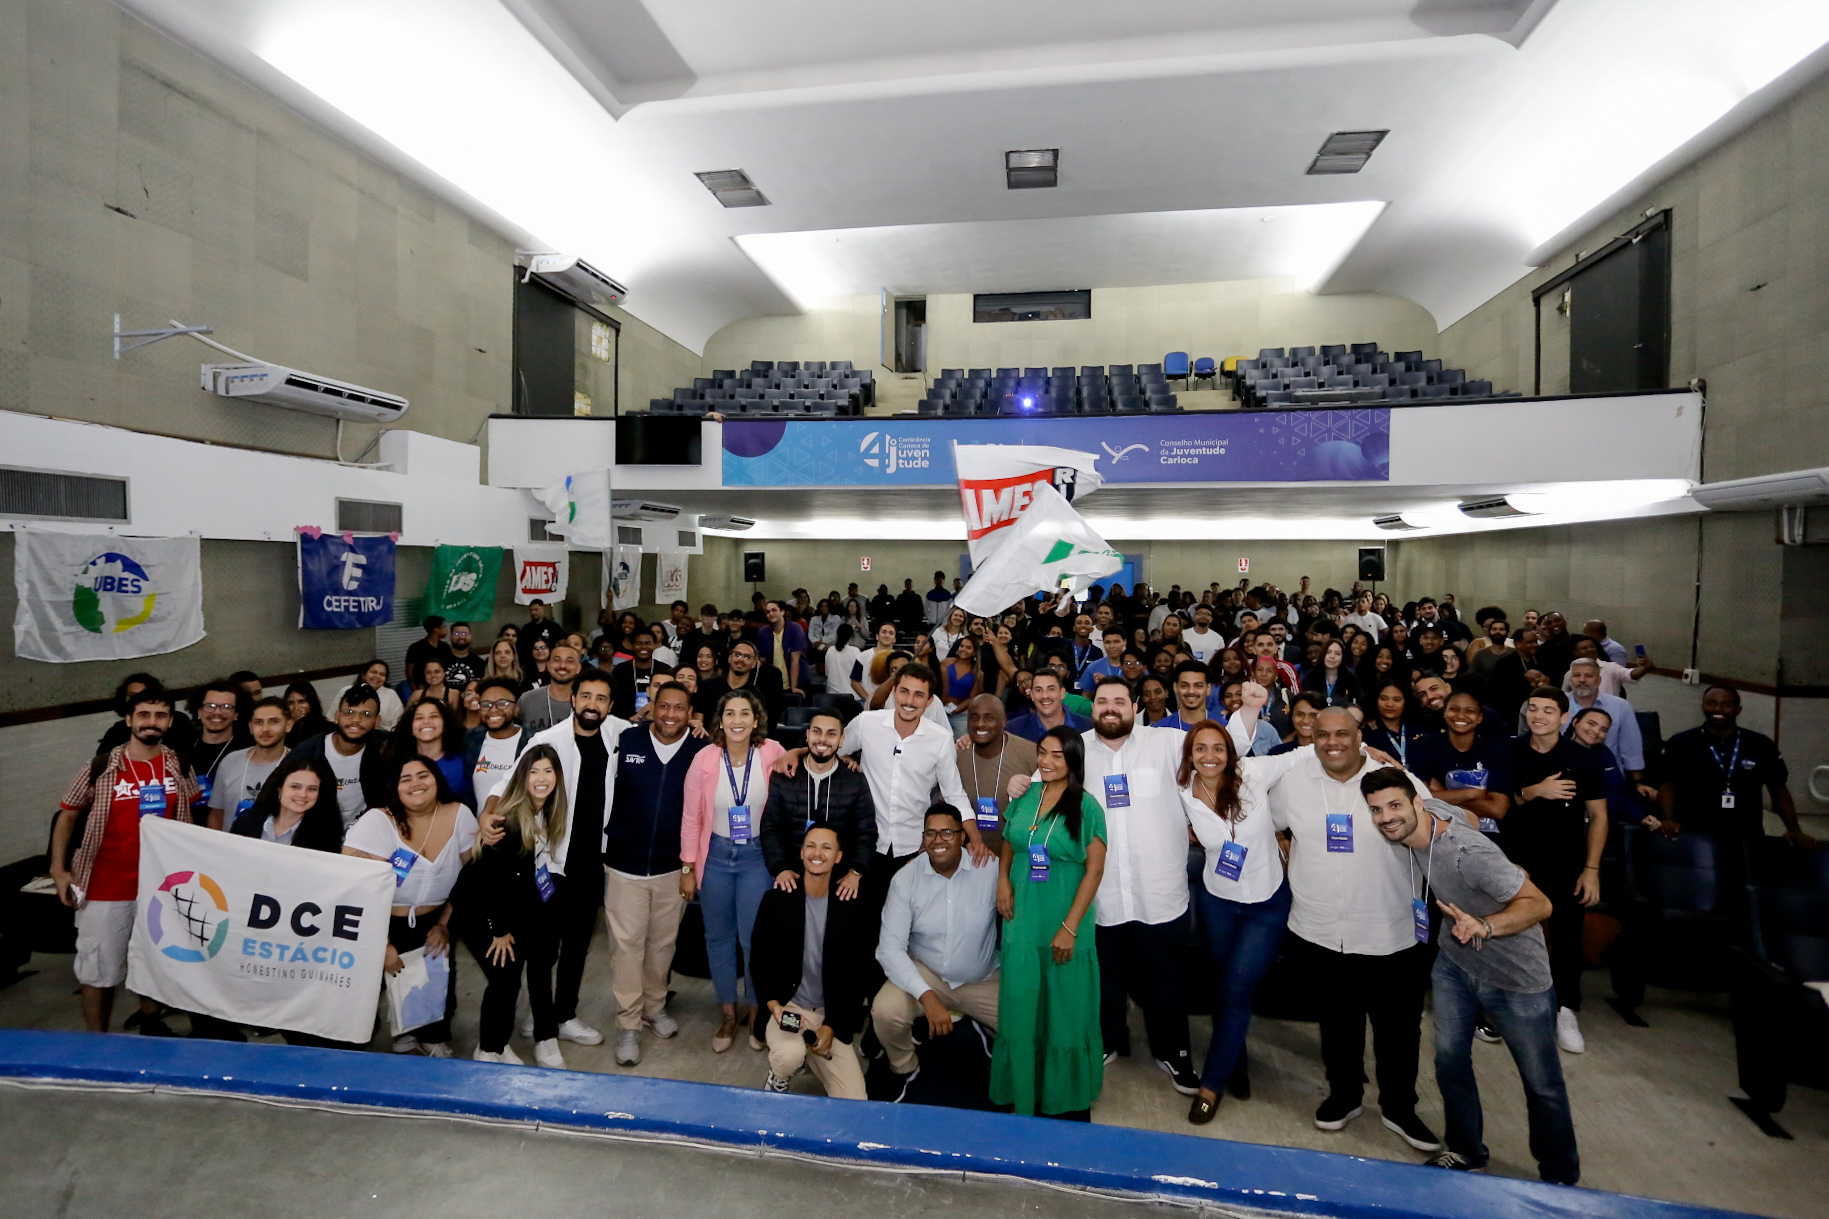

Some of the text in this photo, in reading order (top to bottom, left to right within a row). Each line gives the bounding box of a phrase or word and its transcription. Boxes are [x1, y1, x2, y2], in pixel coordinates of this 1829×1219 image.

[1160, 438, 1229, 448] Conselho Municipal
[1160, 446, 1226, 456] da Juventude
[1160, 456, 1199, 464] Carioca
[93, 575, 143, 594] UBES
[247, 893, 364, 942] DCE
[242, 937, 356, 970] ESTÁCIO
[239, 962, 352, 989] HONESTINO GUIMARÃES
